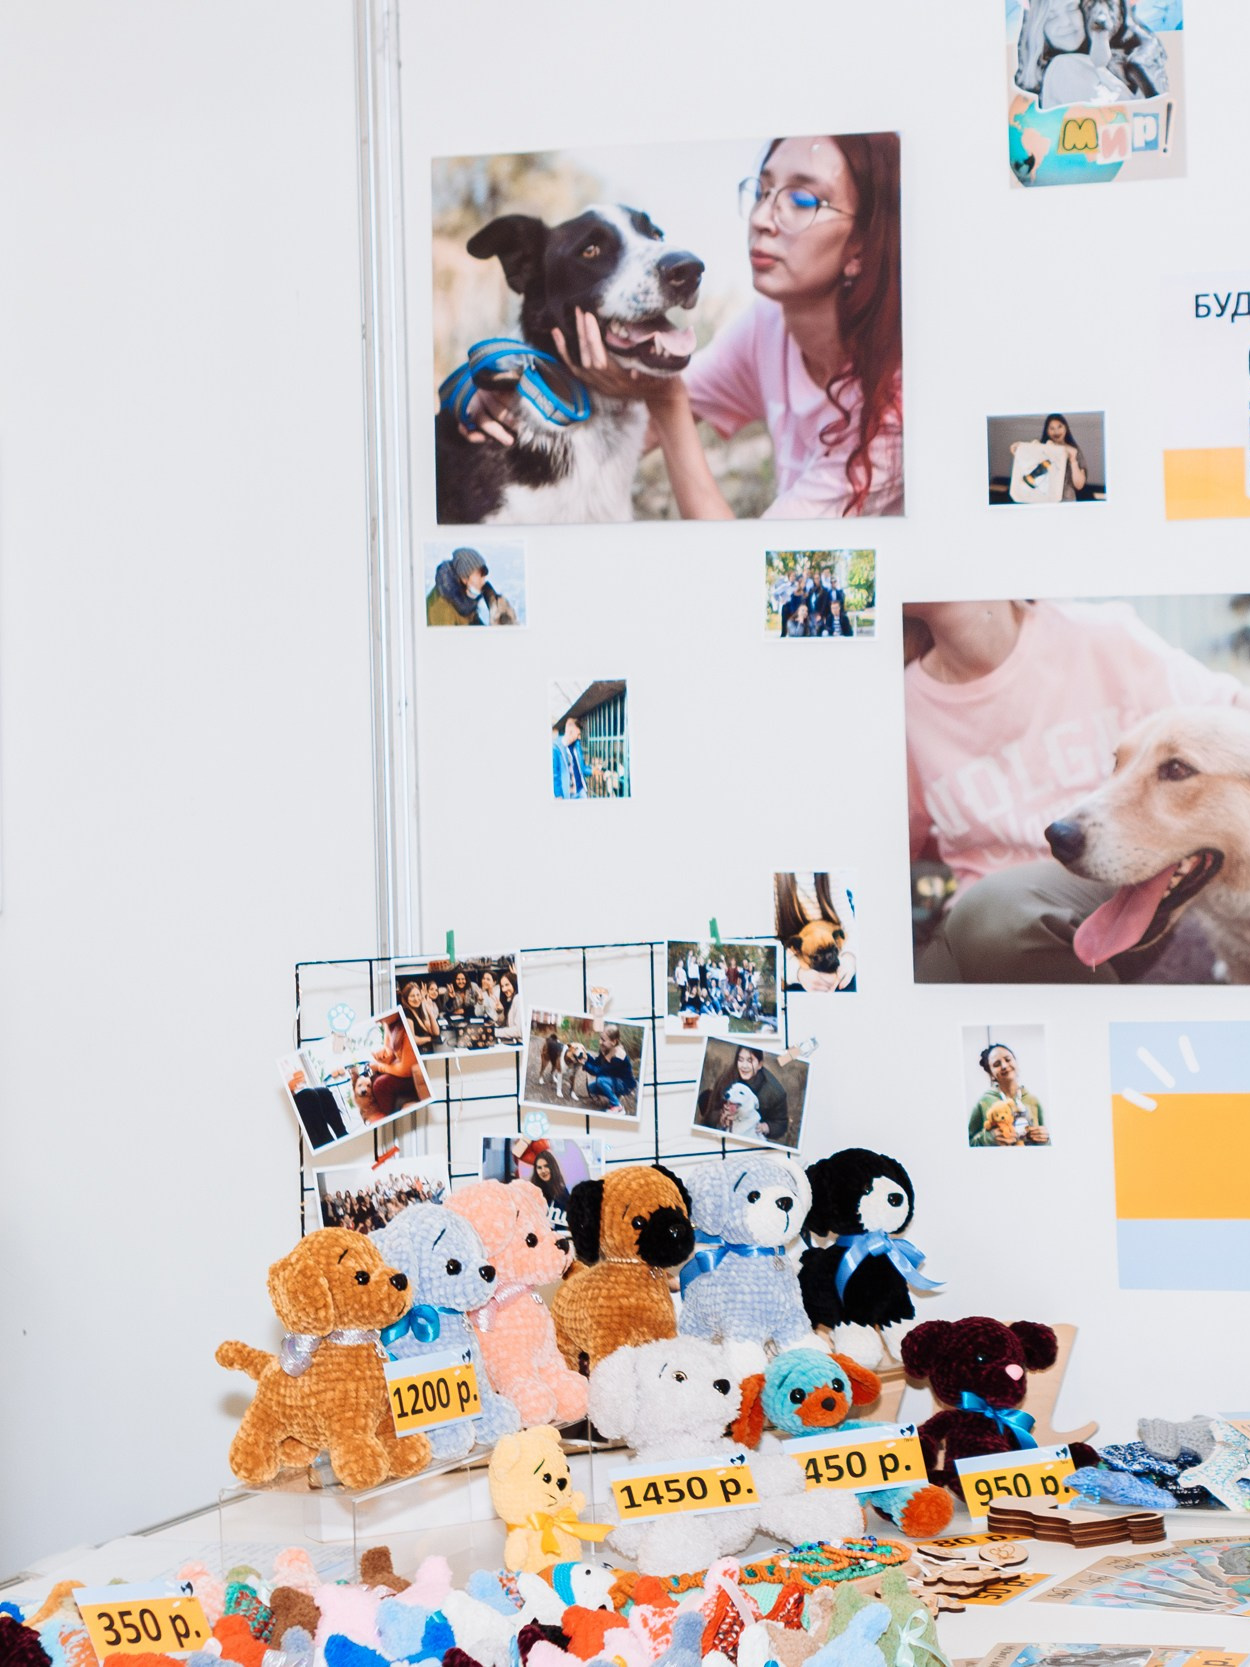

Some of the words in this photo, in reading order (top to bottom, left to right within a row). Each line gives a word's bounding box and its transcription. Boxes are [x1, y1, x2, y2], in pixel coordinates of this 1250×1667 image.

[393, 1378, 451, 1418] 1200
[457, 1380, 478, 1412] р.
[805, 1451, 867, 1483] 450
[879, 1453, 912, 1481] р.
[620, 1476, 708, 1509] 1450
[719, 1478, 754, 1502] р.
[975, 1473, 1032, 1506] 950
[1041, 1475, 1070, 1495] р.
[97, 1608, 162, 1646] 350
[169, 1614, 201, 1648] р.
